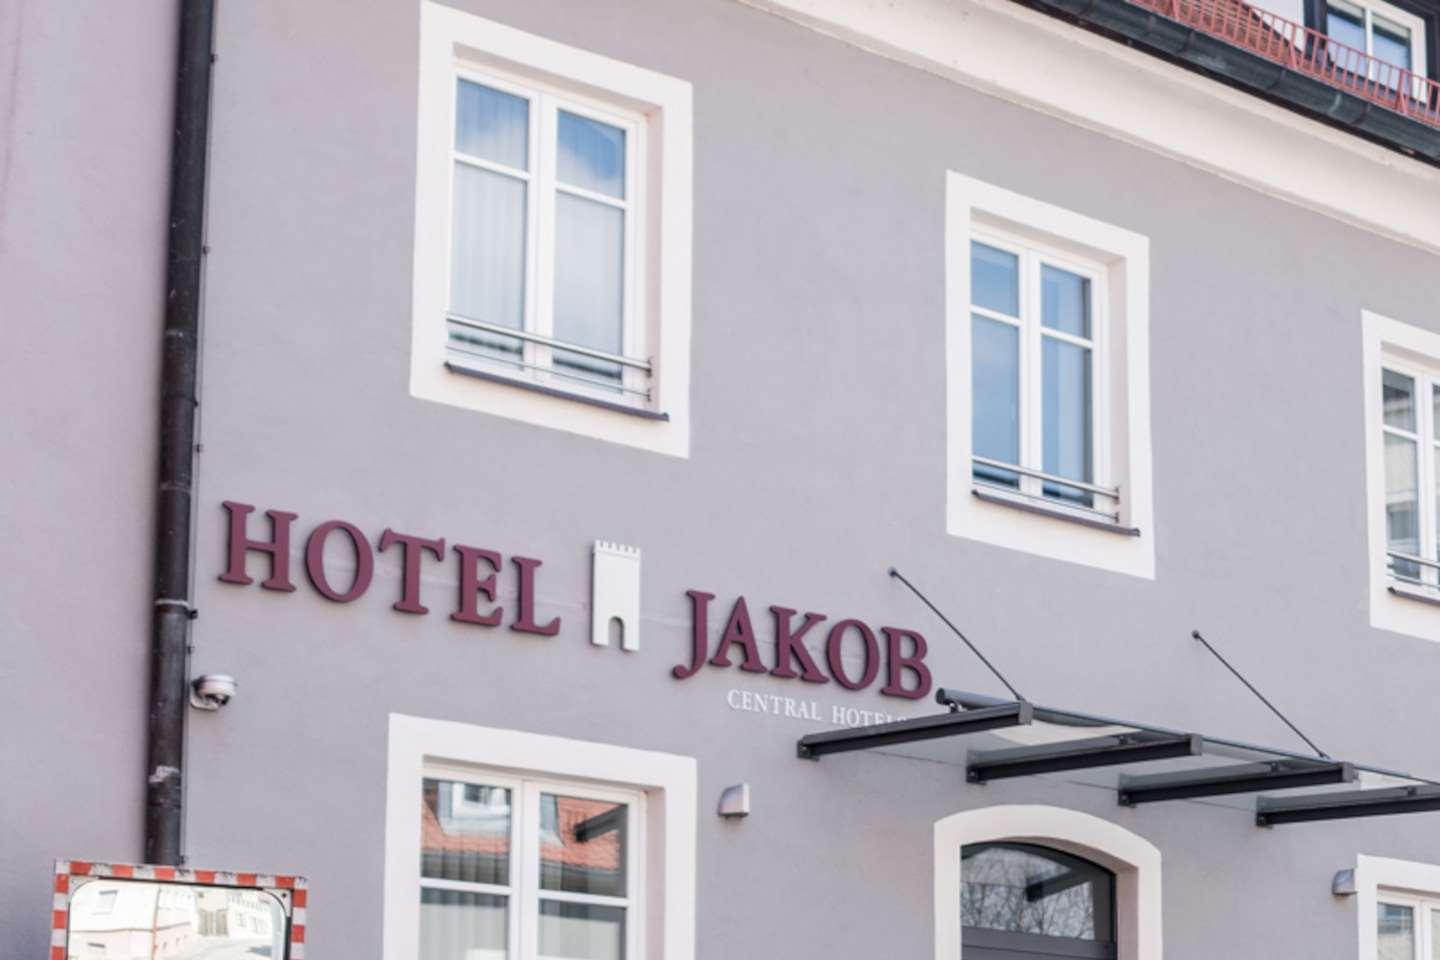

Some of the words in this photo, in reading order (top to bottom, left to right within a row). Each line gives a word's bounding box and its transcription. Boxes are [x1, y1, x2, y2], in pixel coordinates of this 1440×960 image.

[218, 500, 562, 638] HOTEL
[670, 588, 934, 701] JAKOB
[727, 688, 822, 721] CENTRAL
